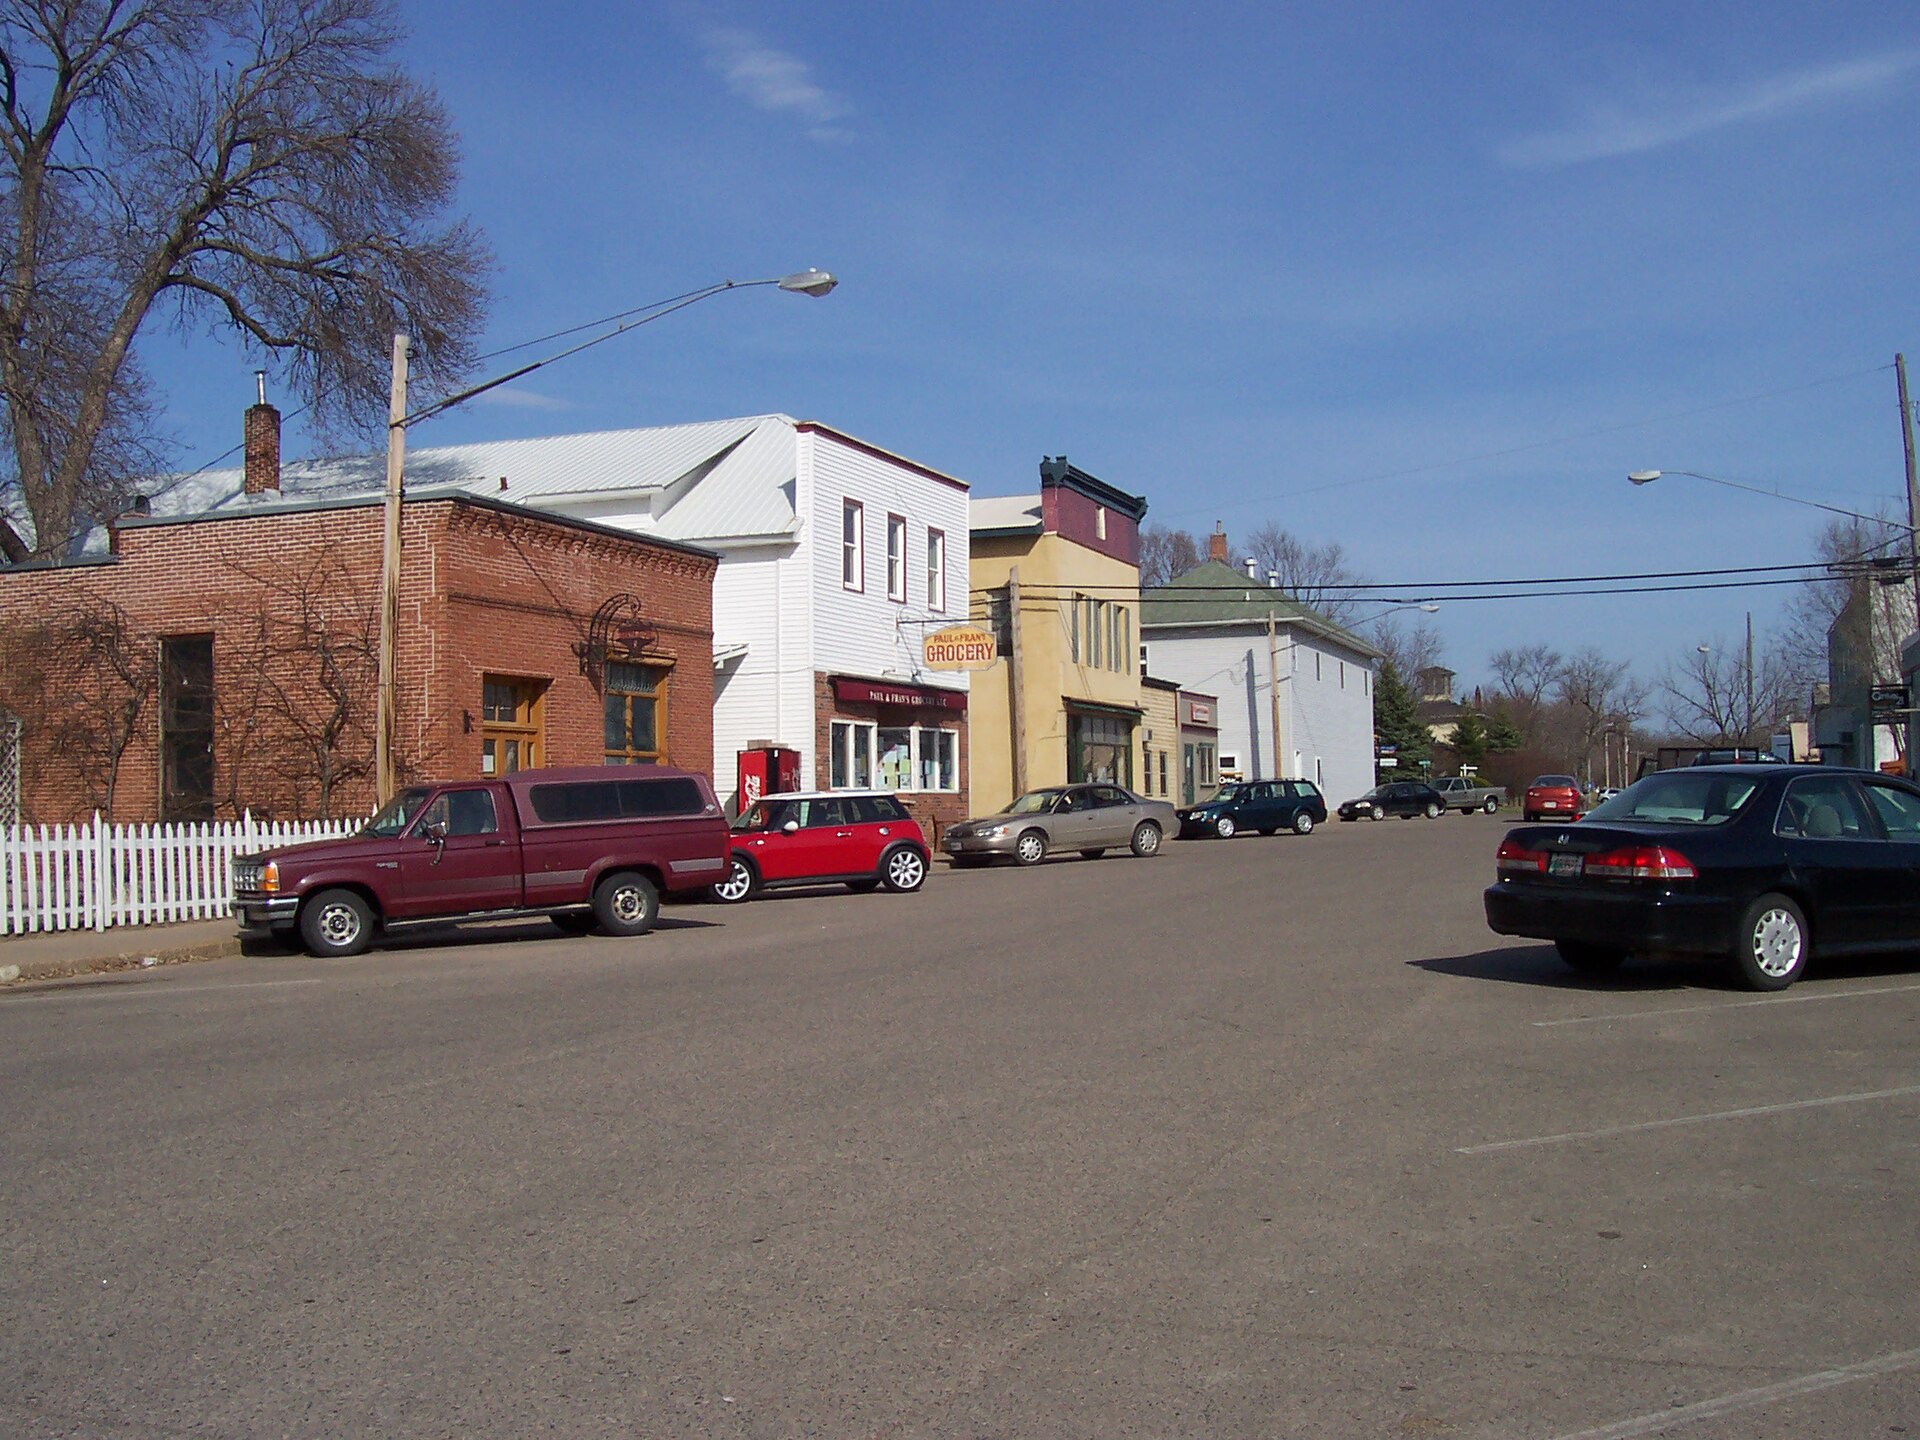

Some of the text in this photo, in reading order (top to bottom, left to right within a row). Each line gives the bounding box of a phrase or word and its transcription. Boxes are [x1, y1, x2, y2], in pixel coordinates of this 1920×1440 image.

[934, 634, 953, 643] PAUL
[926, 643, 994, 662] GROCERY
[869, 690, 884, 702] PAUL
[885, 693, 890, 703] &
